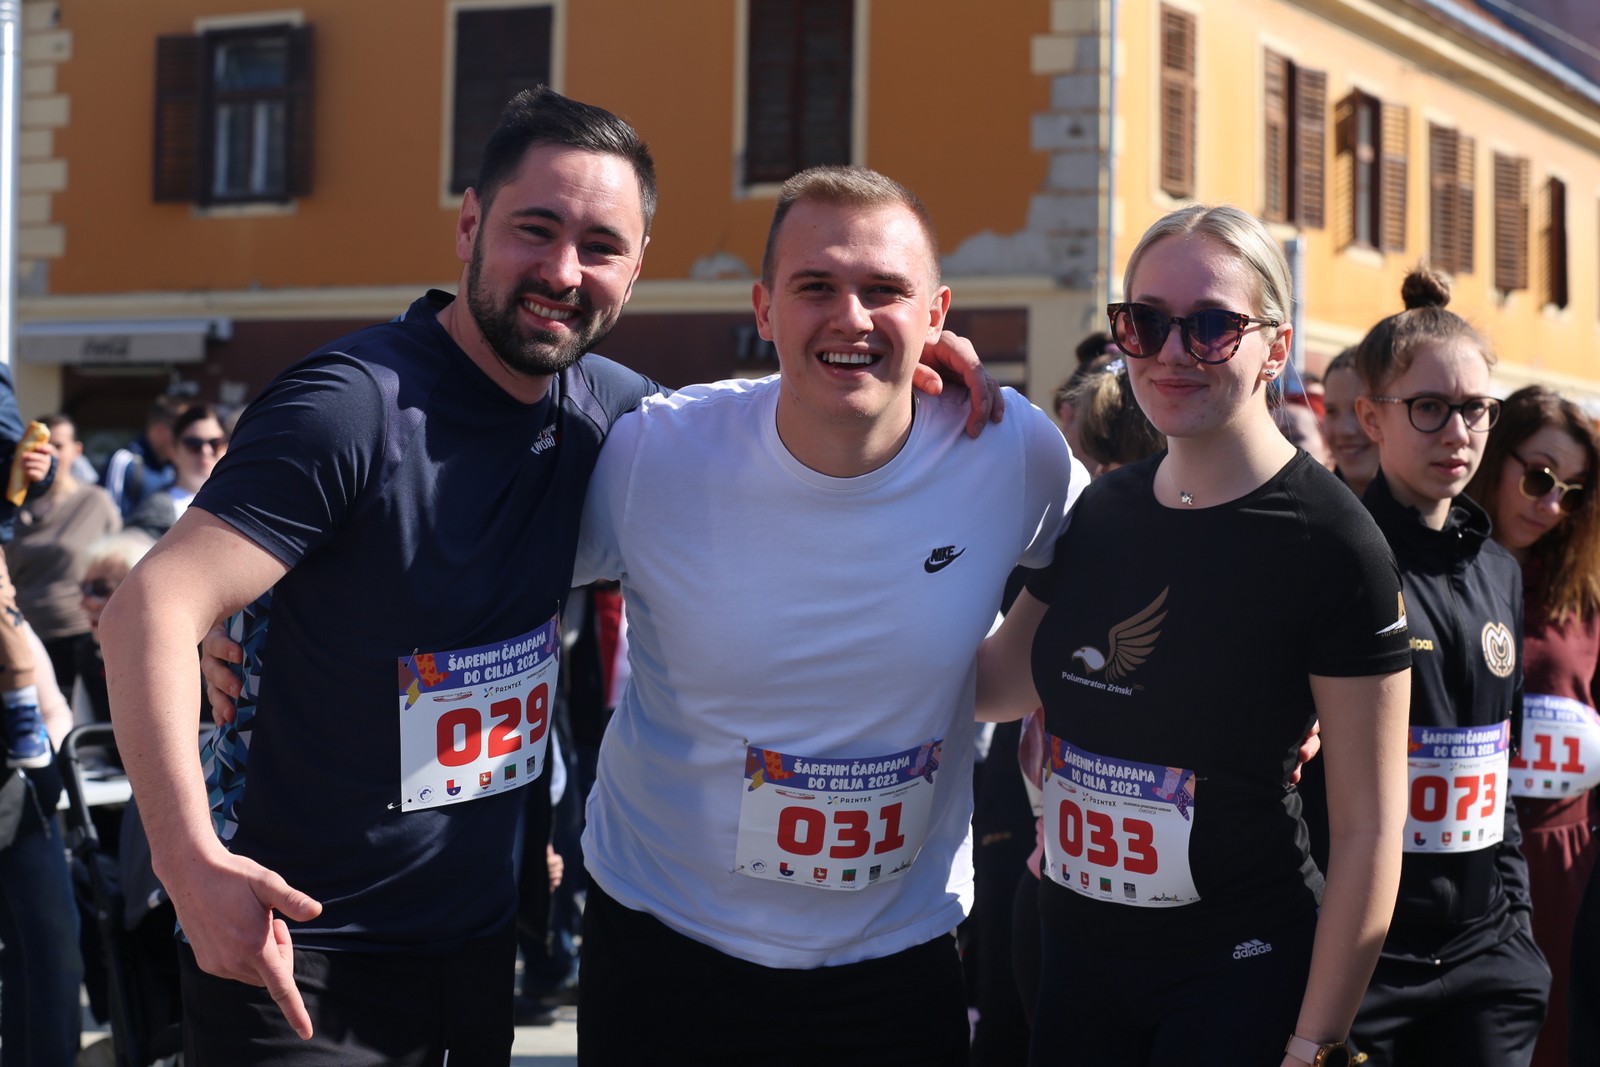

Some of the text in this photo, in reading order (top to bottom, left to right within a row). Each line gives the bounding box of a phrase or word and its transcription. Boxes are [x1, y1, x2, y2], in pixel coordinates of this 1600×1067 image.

[930, 545, 955, 562] NIKE
[448, 650, 500, 672] ŠARENIM
[501, 631, 546, 660] ČARAPAMA
[463, 671, 480, 685] DO
[484, 664, 514, 681] CILJA
[517, 652, 540, 672] 2023.
[1062, 671, 1106, 690] Polumaraton
[1107, 683, 1133, 696] Zrinski
[436, 683, 549, 767] 029
[793, 755, 910, 776] ŠARENIM ČARAPAMA
[1063, 747, 1156, 784] ŠARENIM ČARAPAMA
[1433, 745, 1448, 757] DO
[1450, 745, 1476, 757] CILJA
[807, 777, 826, 789] DO
[829, 777, 864, 790] CILJA
[868, 773, 899, 788] 2023.
[1071, 769, 1081, 783] DO
[1082, 772, 1107, 791] CILJA
[1110, 780, 1143, 797] 2023.
[1410, 772, 1497, 822] 073
[776, 802, 905, 859] 031
[1059, 799, 1158, 875] 033
[1232, 943, 1272, 960] adidas
